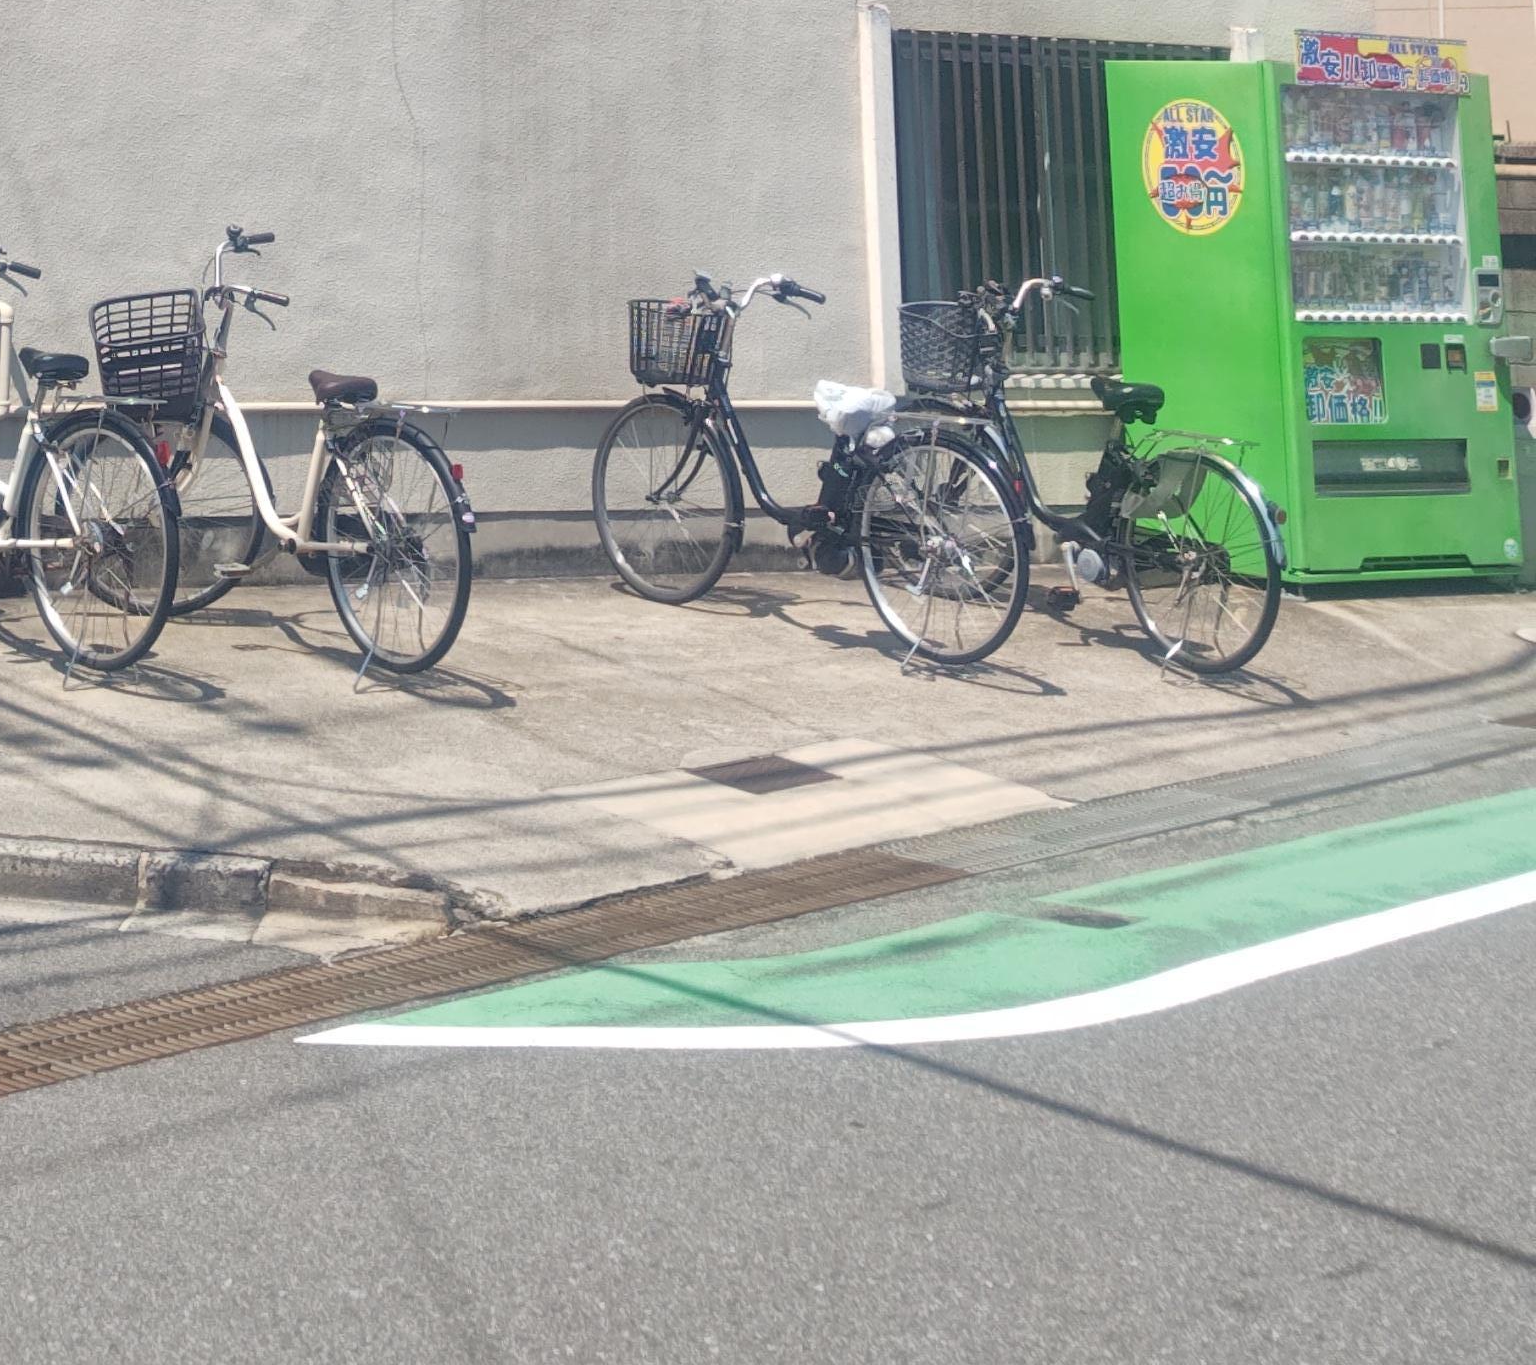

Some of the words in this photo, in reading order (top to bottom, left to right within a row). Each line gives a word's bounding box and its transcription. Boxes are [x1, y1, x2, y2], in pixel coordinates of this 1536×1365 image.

[1163, 109, 1184, 123] ALL
[1186, 108, 1215, 123] STAR
[1164, 126, 1218, 160] 激安
